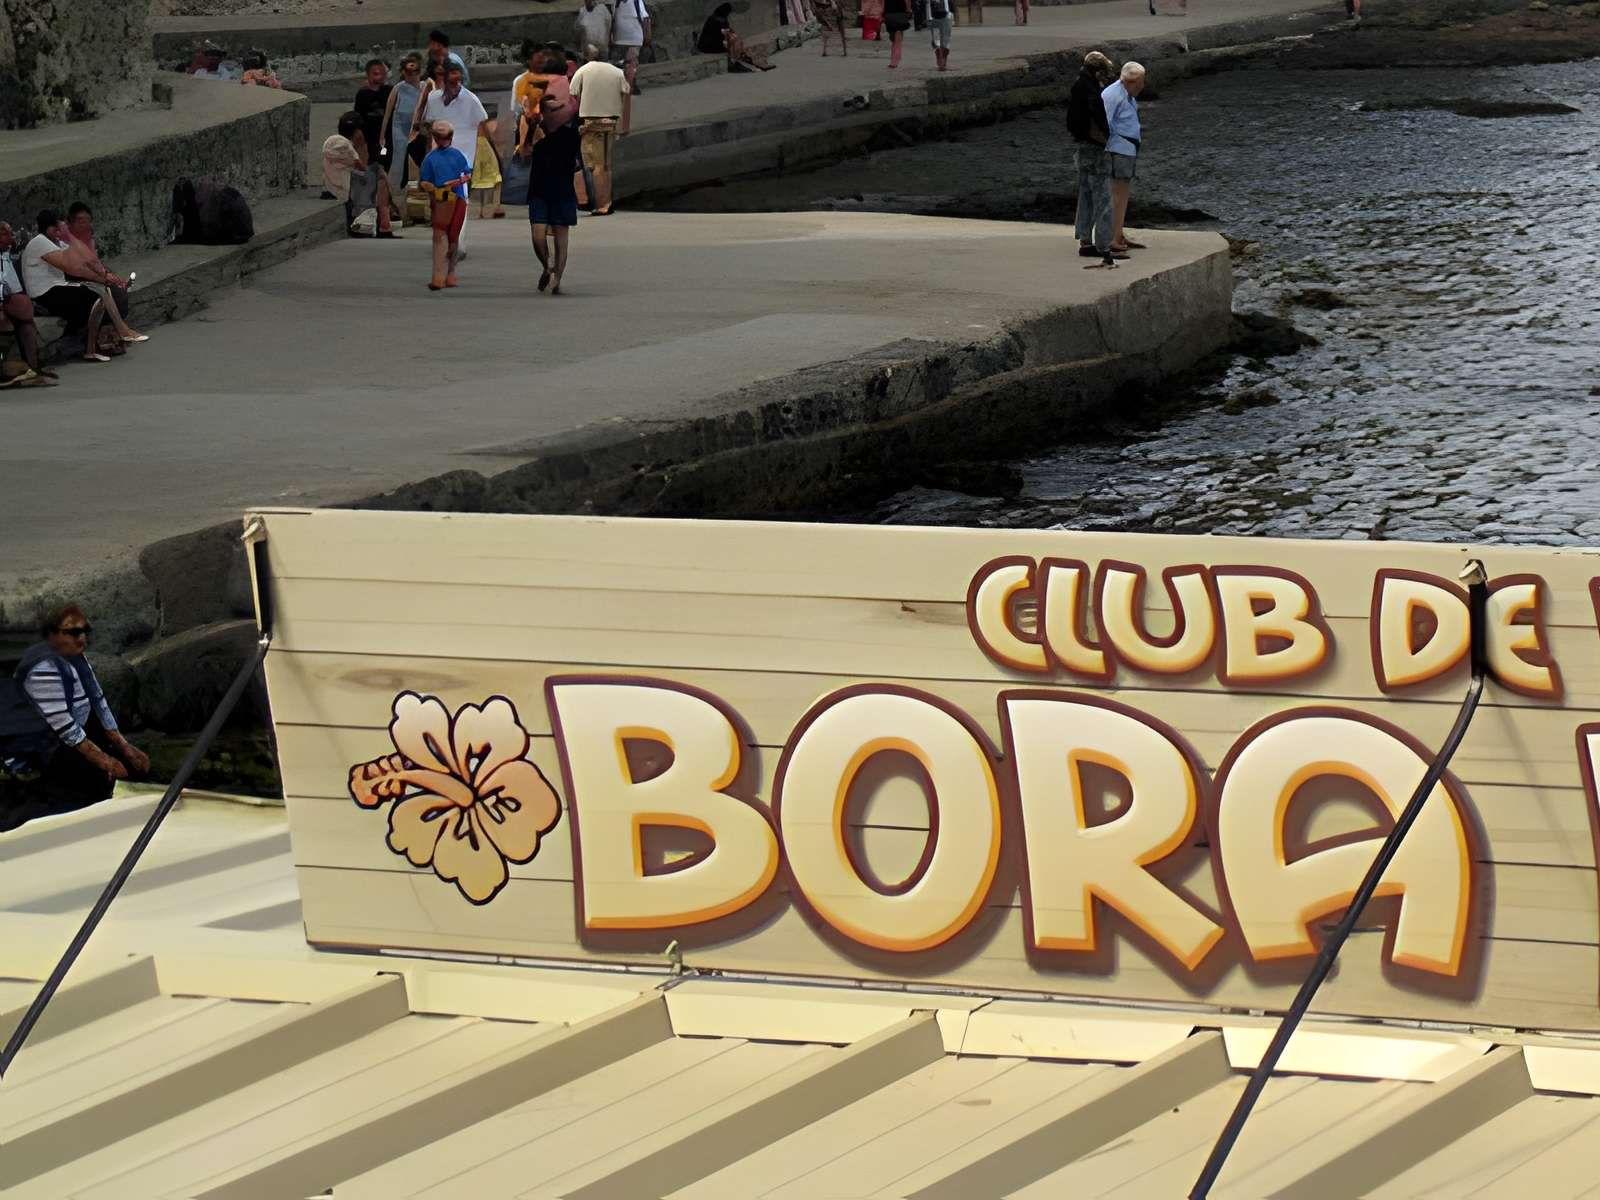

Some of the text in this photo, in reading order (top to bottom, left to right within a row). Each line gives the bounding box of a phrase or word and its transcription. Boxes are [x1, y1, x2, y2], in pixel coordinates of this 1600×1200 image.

[967, 554, 1330, 686] CLUB
[1370, 567, 1566, 702] DE
[545, 674, 1482, 986] BORA
